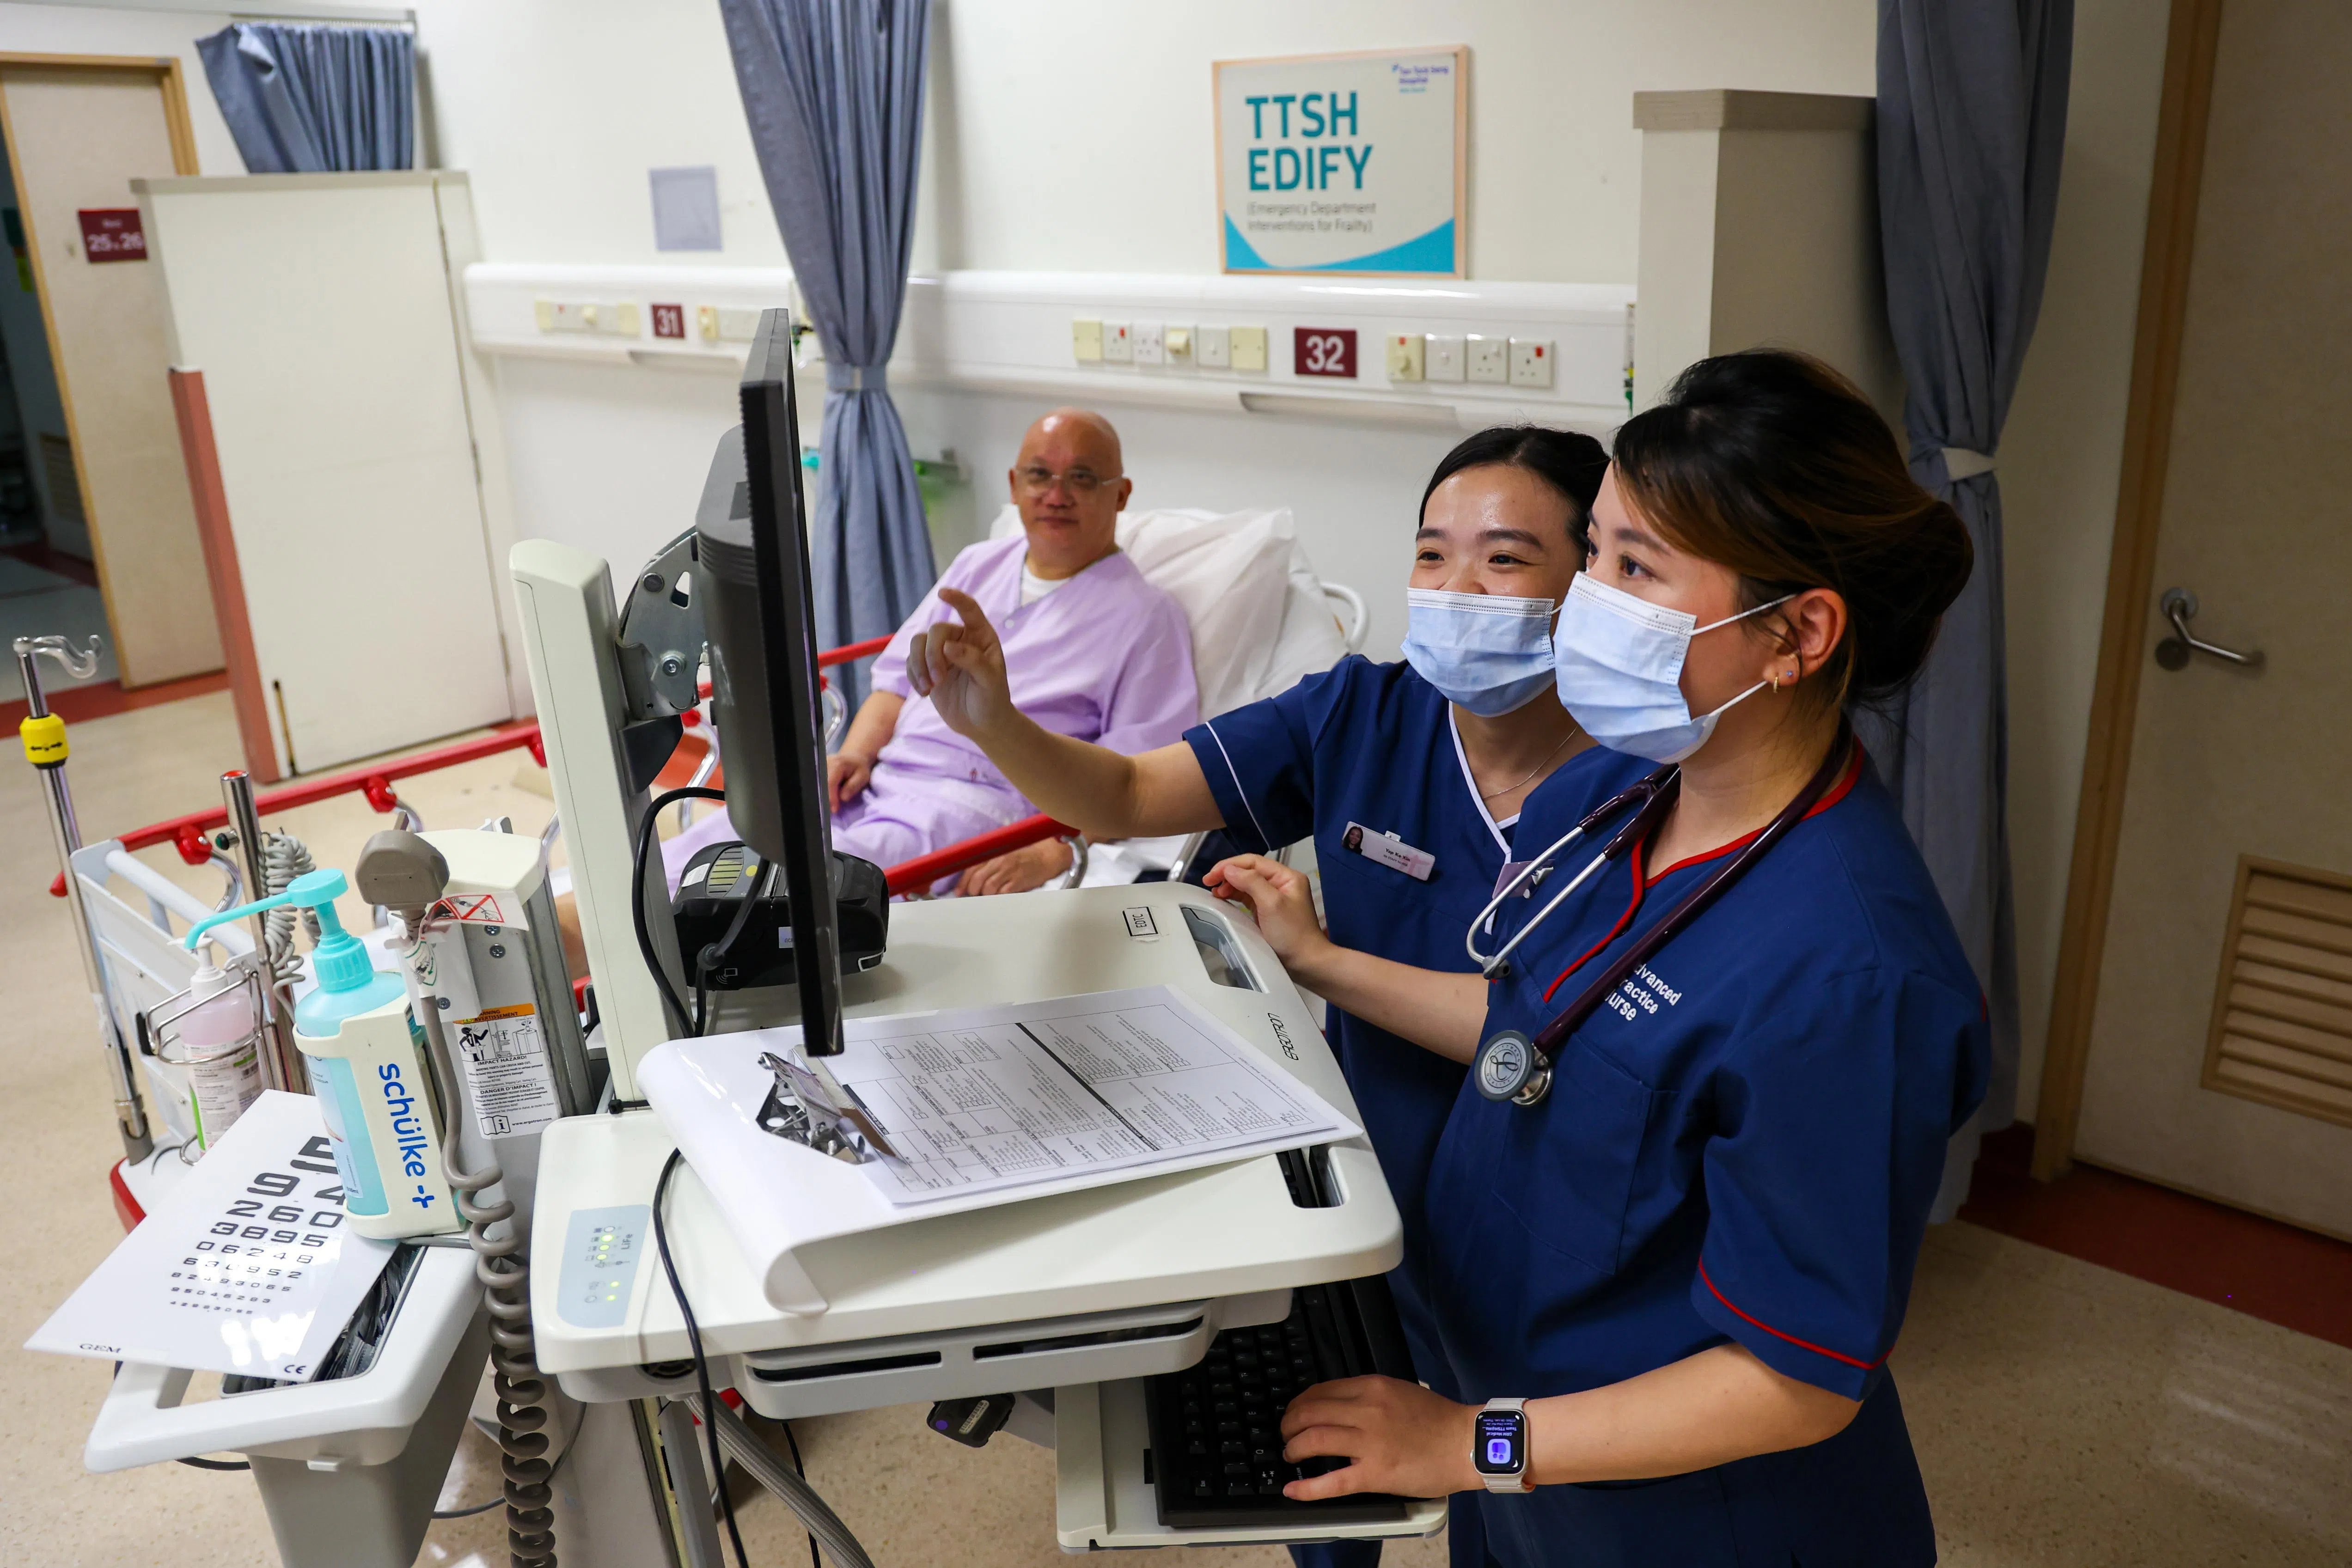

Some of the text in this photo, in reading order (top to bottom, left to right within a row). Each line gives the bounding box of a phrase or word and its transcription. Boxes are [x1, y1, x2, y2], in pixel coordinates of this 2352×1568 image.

[1245, 90, 1357, 140] TTSH
[1248, 144, 1373, 191] EDIFY
[1311, 201, 1376, 214] Department
[1248, 220, 1315, 232] Interventions
[1318, 218, 1332, 231] for
[657, 308, 678, 335] 31
[1305, 336, 1345, 372] 32
[1132, 914, 1147, 928] EDTC
[1634, 963, 1682, 1006] dvanced
[474, 1012, 518, 1021] AVERTISSEMENT
[1268, 1013, 1299, 1061] ERGOTRON
[379, 1063, 428, 1177] schülke
[512, 1117, 552, 1126] www.ergotron.com
[247, 1173, 300, 1197] 9
